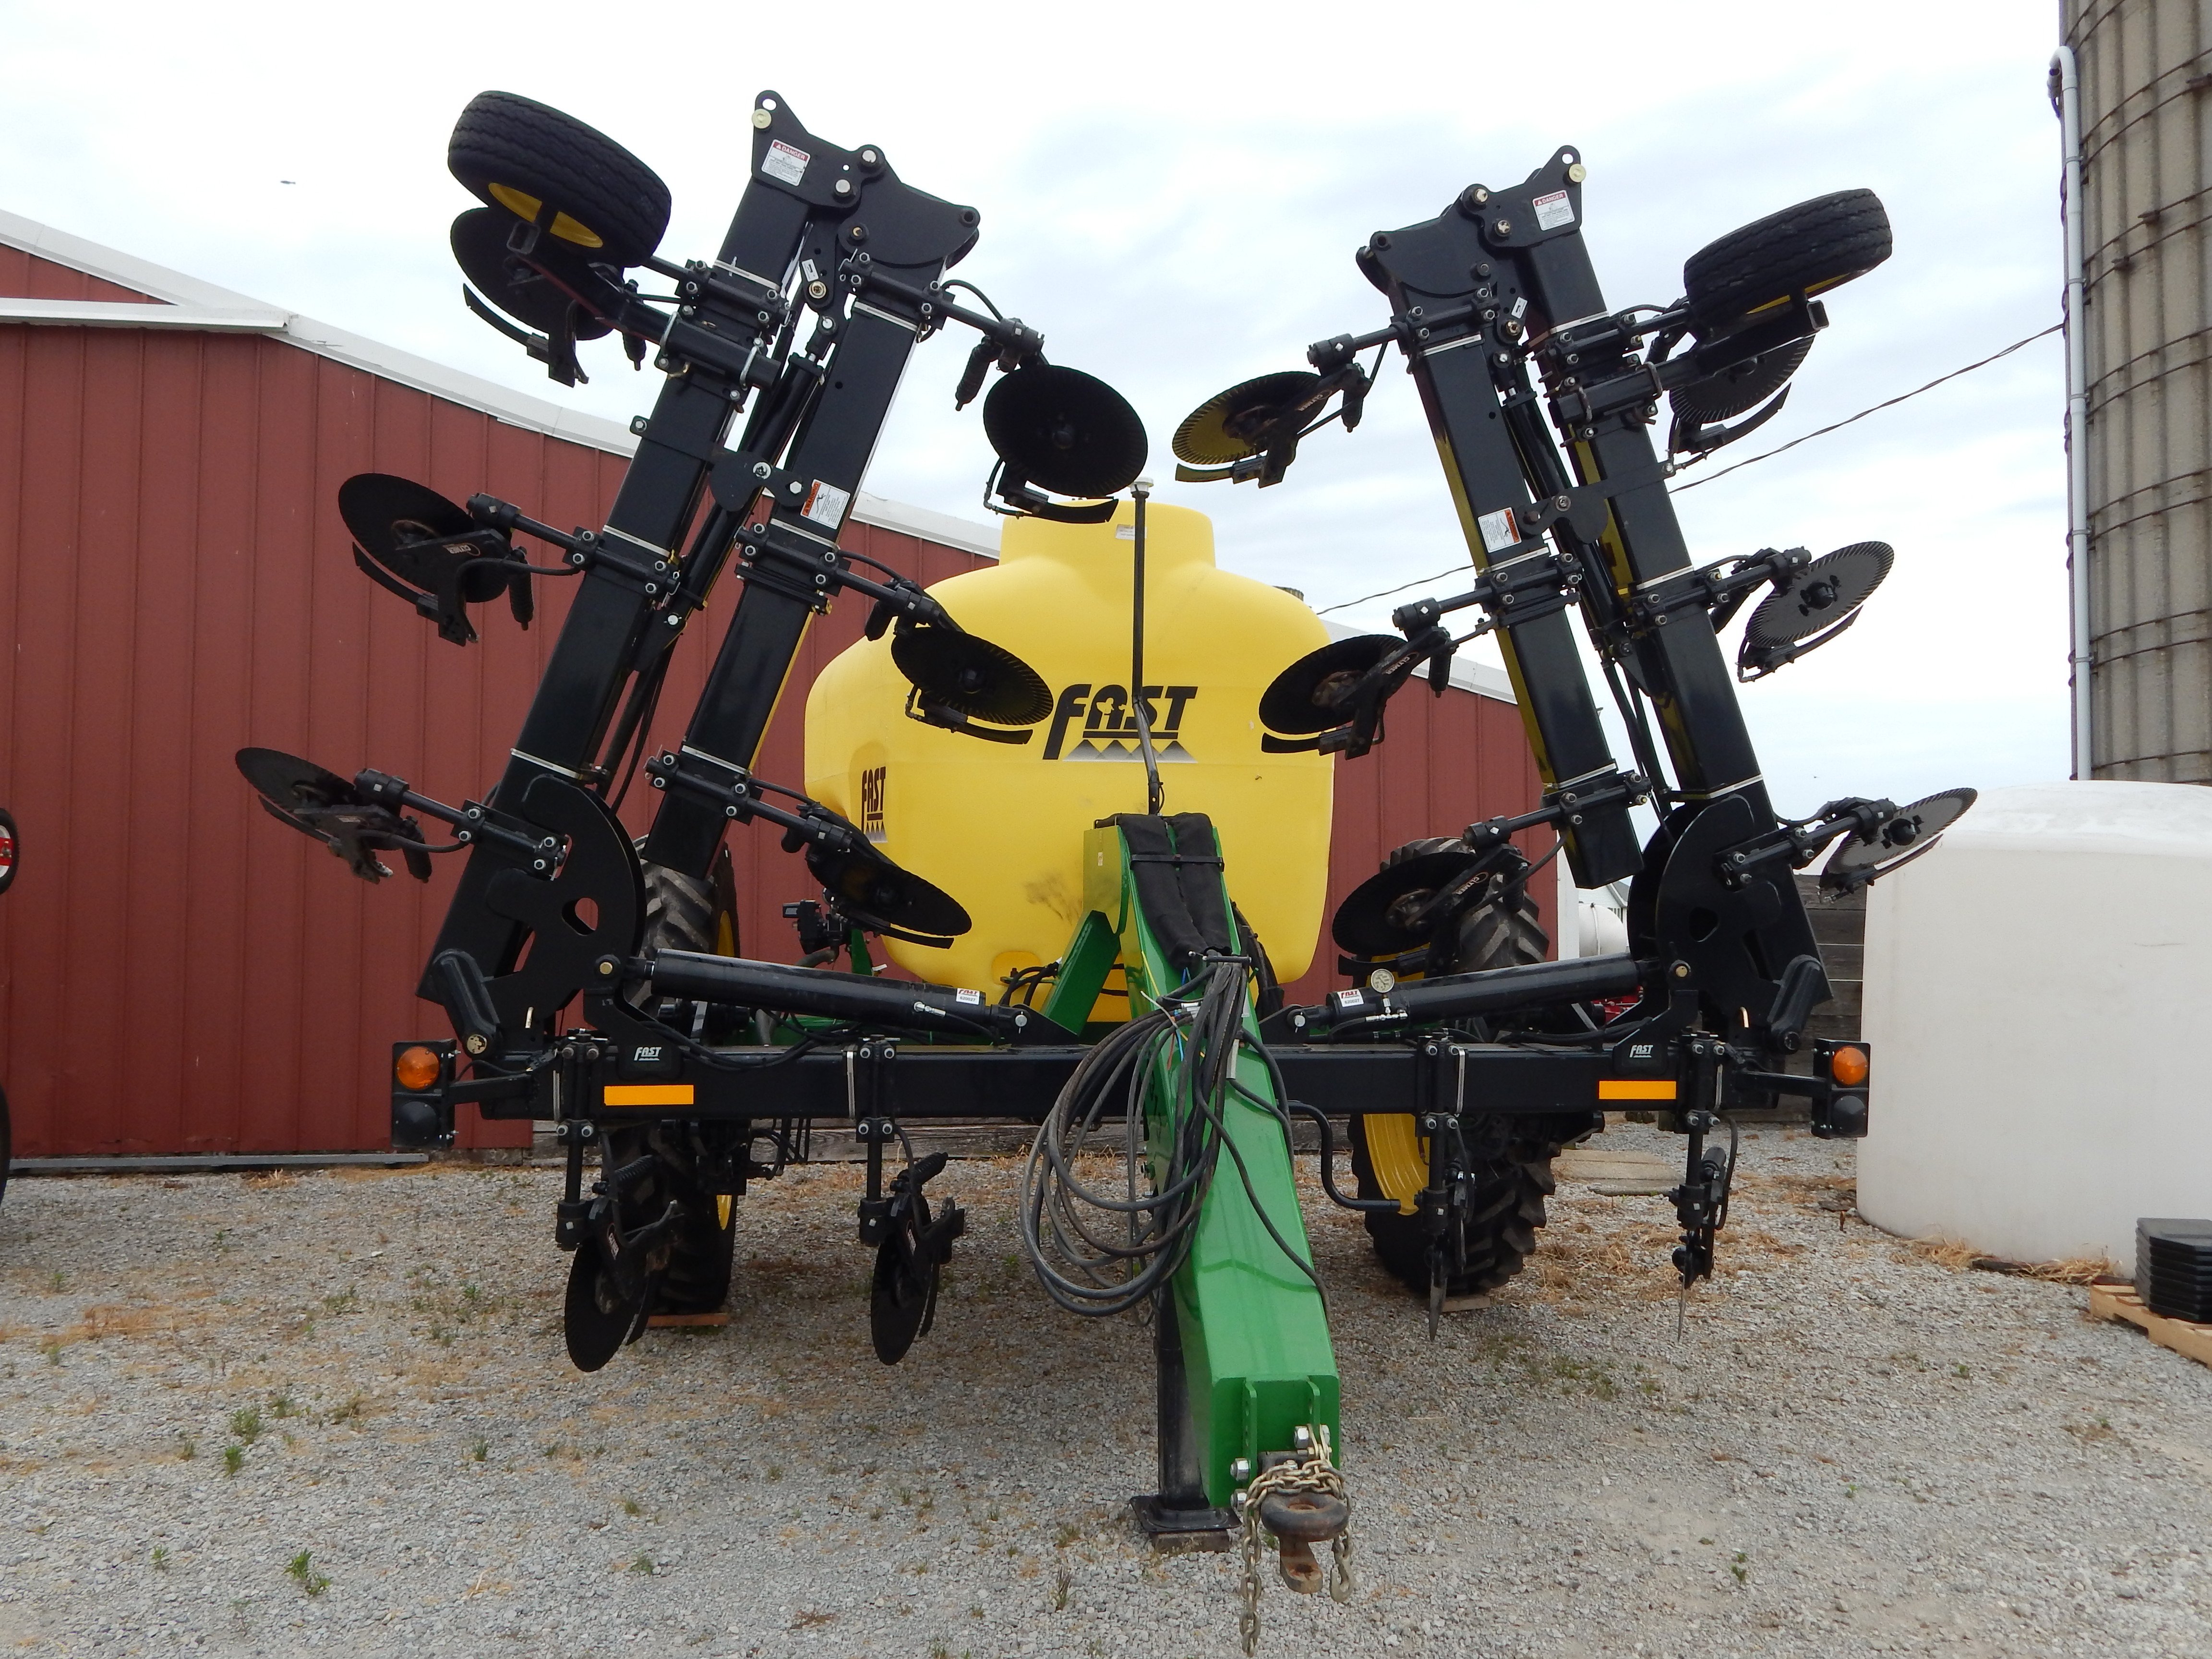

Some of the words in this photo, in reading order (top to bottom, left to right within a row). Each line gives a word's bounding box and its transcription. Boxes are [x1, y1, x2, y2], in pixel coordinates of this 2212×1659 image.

[781, 146, 805, 160] DANGER
[1542, 193, 1563, 204] DANGER
[1385, 657, 1410, 674] CLYMER
[1043, 683, 1198, 760] FAST
[861, 766, 886, 834] FAST
[1455, 877, 1479, 894] CLYMER
[1341, 990, 1358, 998] FAST
[634, 1046, 661, 1061] FAST
[1629, 1045, 1654, 1058] FAST
